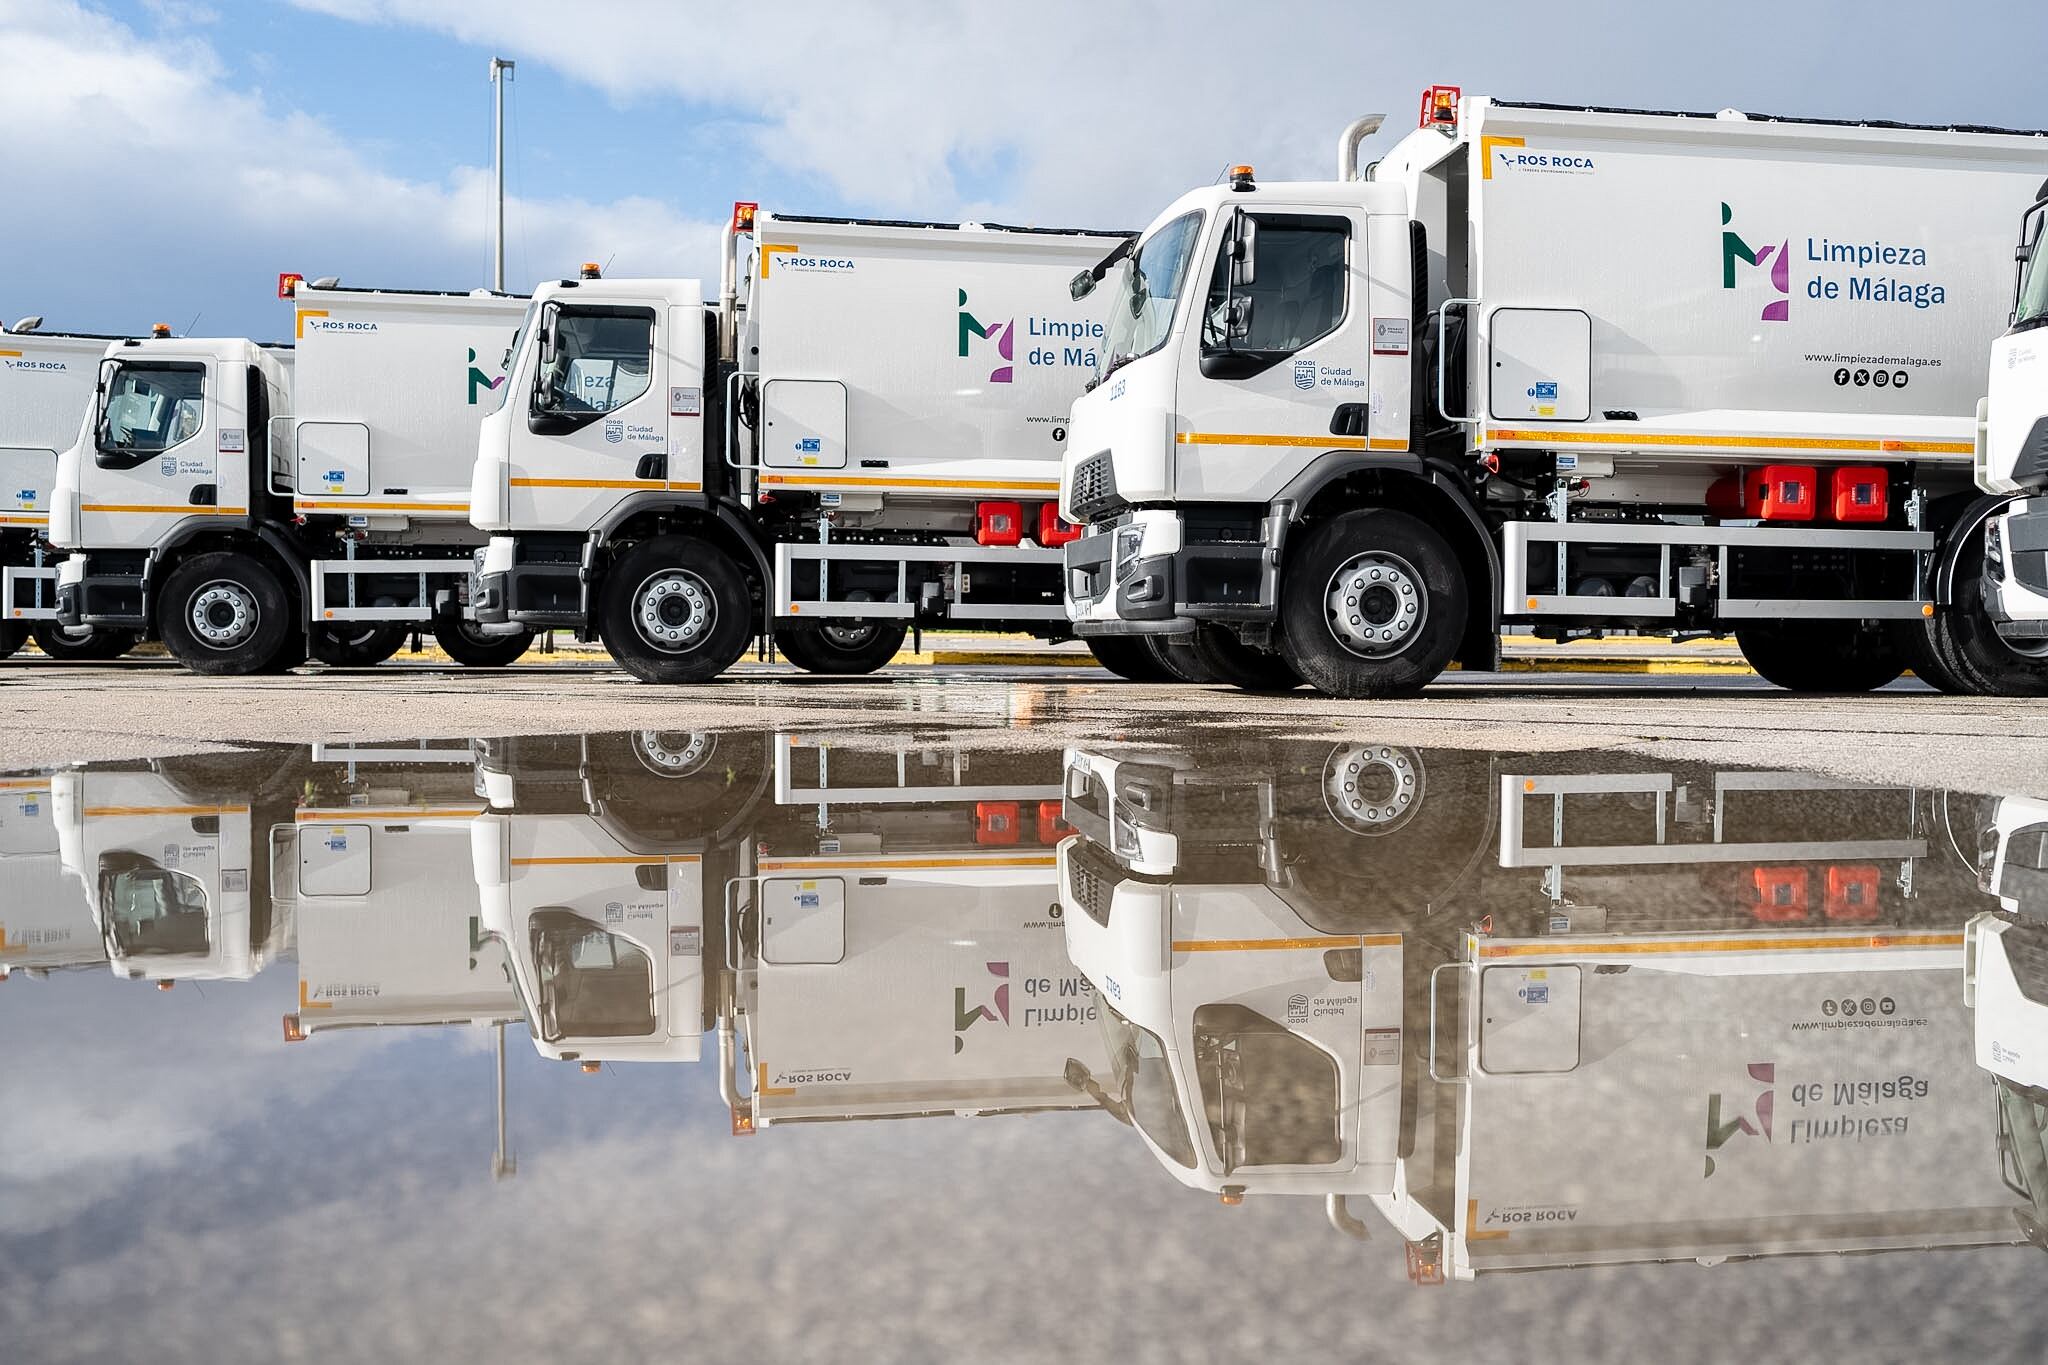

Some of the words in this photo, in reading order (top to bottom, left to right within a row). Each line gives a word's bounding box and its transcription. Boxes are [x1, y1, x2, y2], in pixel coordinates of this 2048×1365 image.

[1517, 155, 1548, 166] ROS
[1552, 156, 1594, 169] ROCA
[1807, 237, 1927, 268] Limpieza
[791, 258, 816, 267] ROS
[820, 259, 855, 269] ROCA
[1806, 276, 1840, 299] de
[1849, 277, 1946, 309] Málaga
[322, 321, 345, 330] ROS
[347, 322, 378, 331] ROCA
[1029, 317, 1104, 341] Limpie
[1028, 347, 1056, 366] de
[1804, 353, 1943, 367] www.limpiezademalaga.es
[16, 361, 37, 369] ROS
[39, 362, 67, 370] ROCA
[1320, 367, 1352, 376] Ciudad
[1334, 378, 1365, 388] Málaga
[627, 425, 654, 433] Ciudad
[638, 433, 664, 442] Málaga
